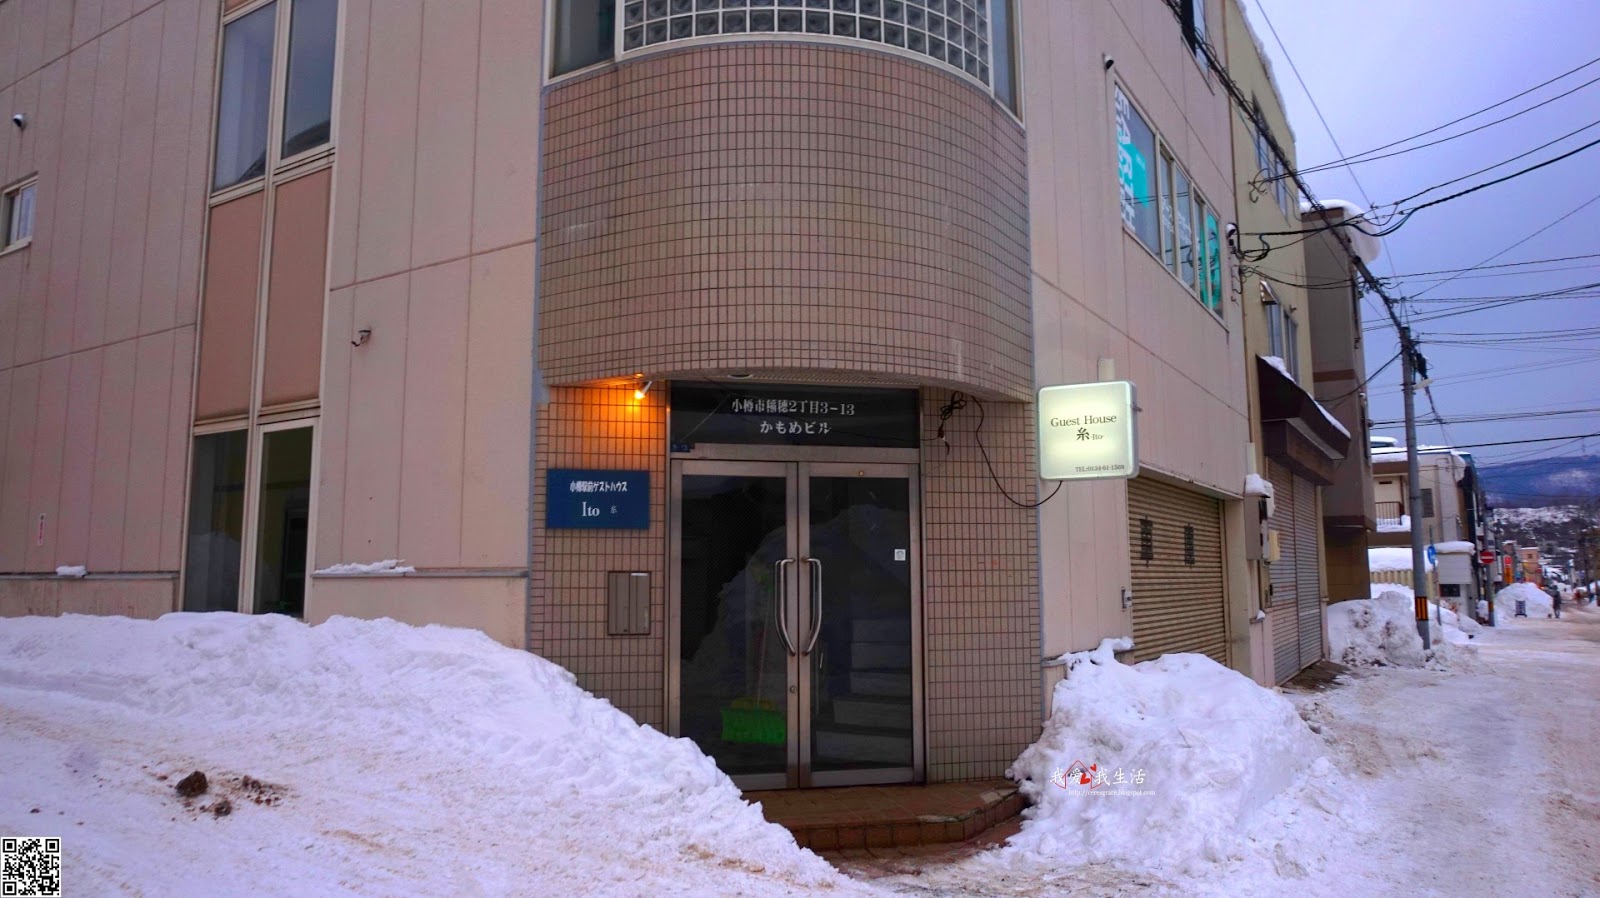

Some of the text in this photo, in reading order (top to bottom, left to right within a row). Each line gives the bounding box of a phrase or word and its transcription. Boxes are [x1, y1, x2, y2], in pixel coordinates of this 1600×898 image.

[760, 421, 832, 434] かもめビル
[1050, 415, 1117, 427] Guest House
[1076, 427, 1090, 441] 糸
[582, 501, 600, 517] Ito
